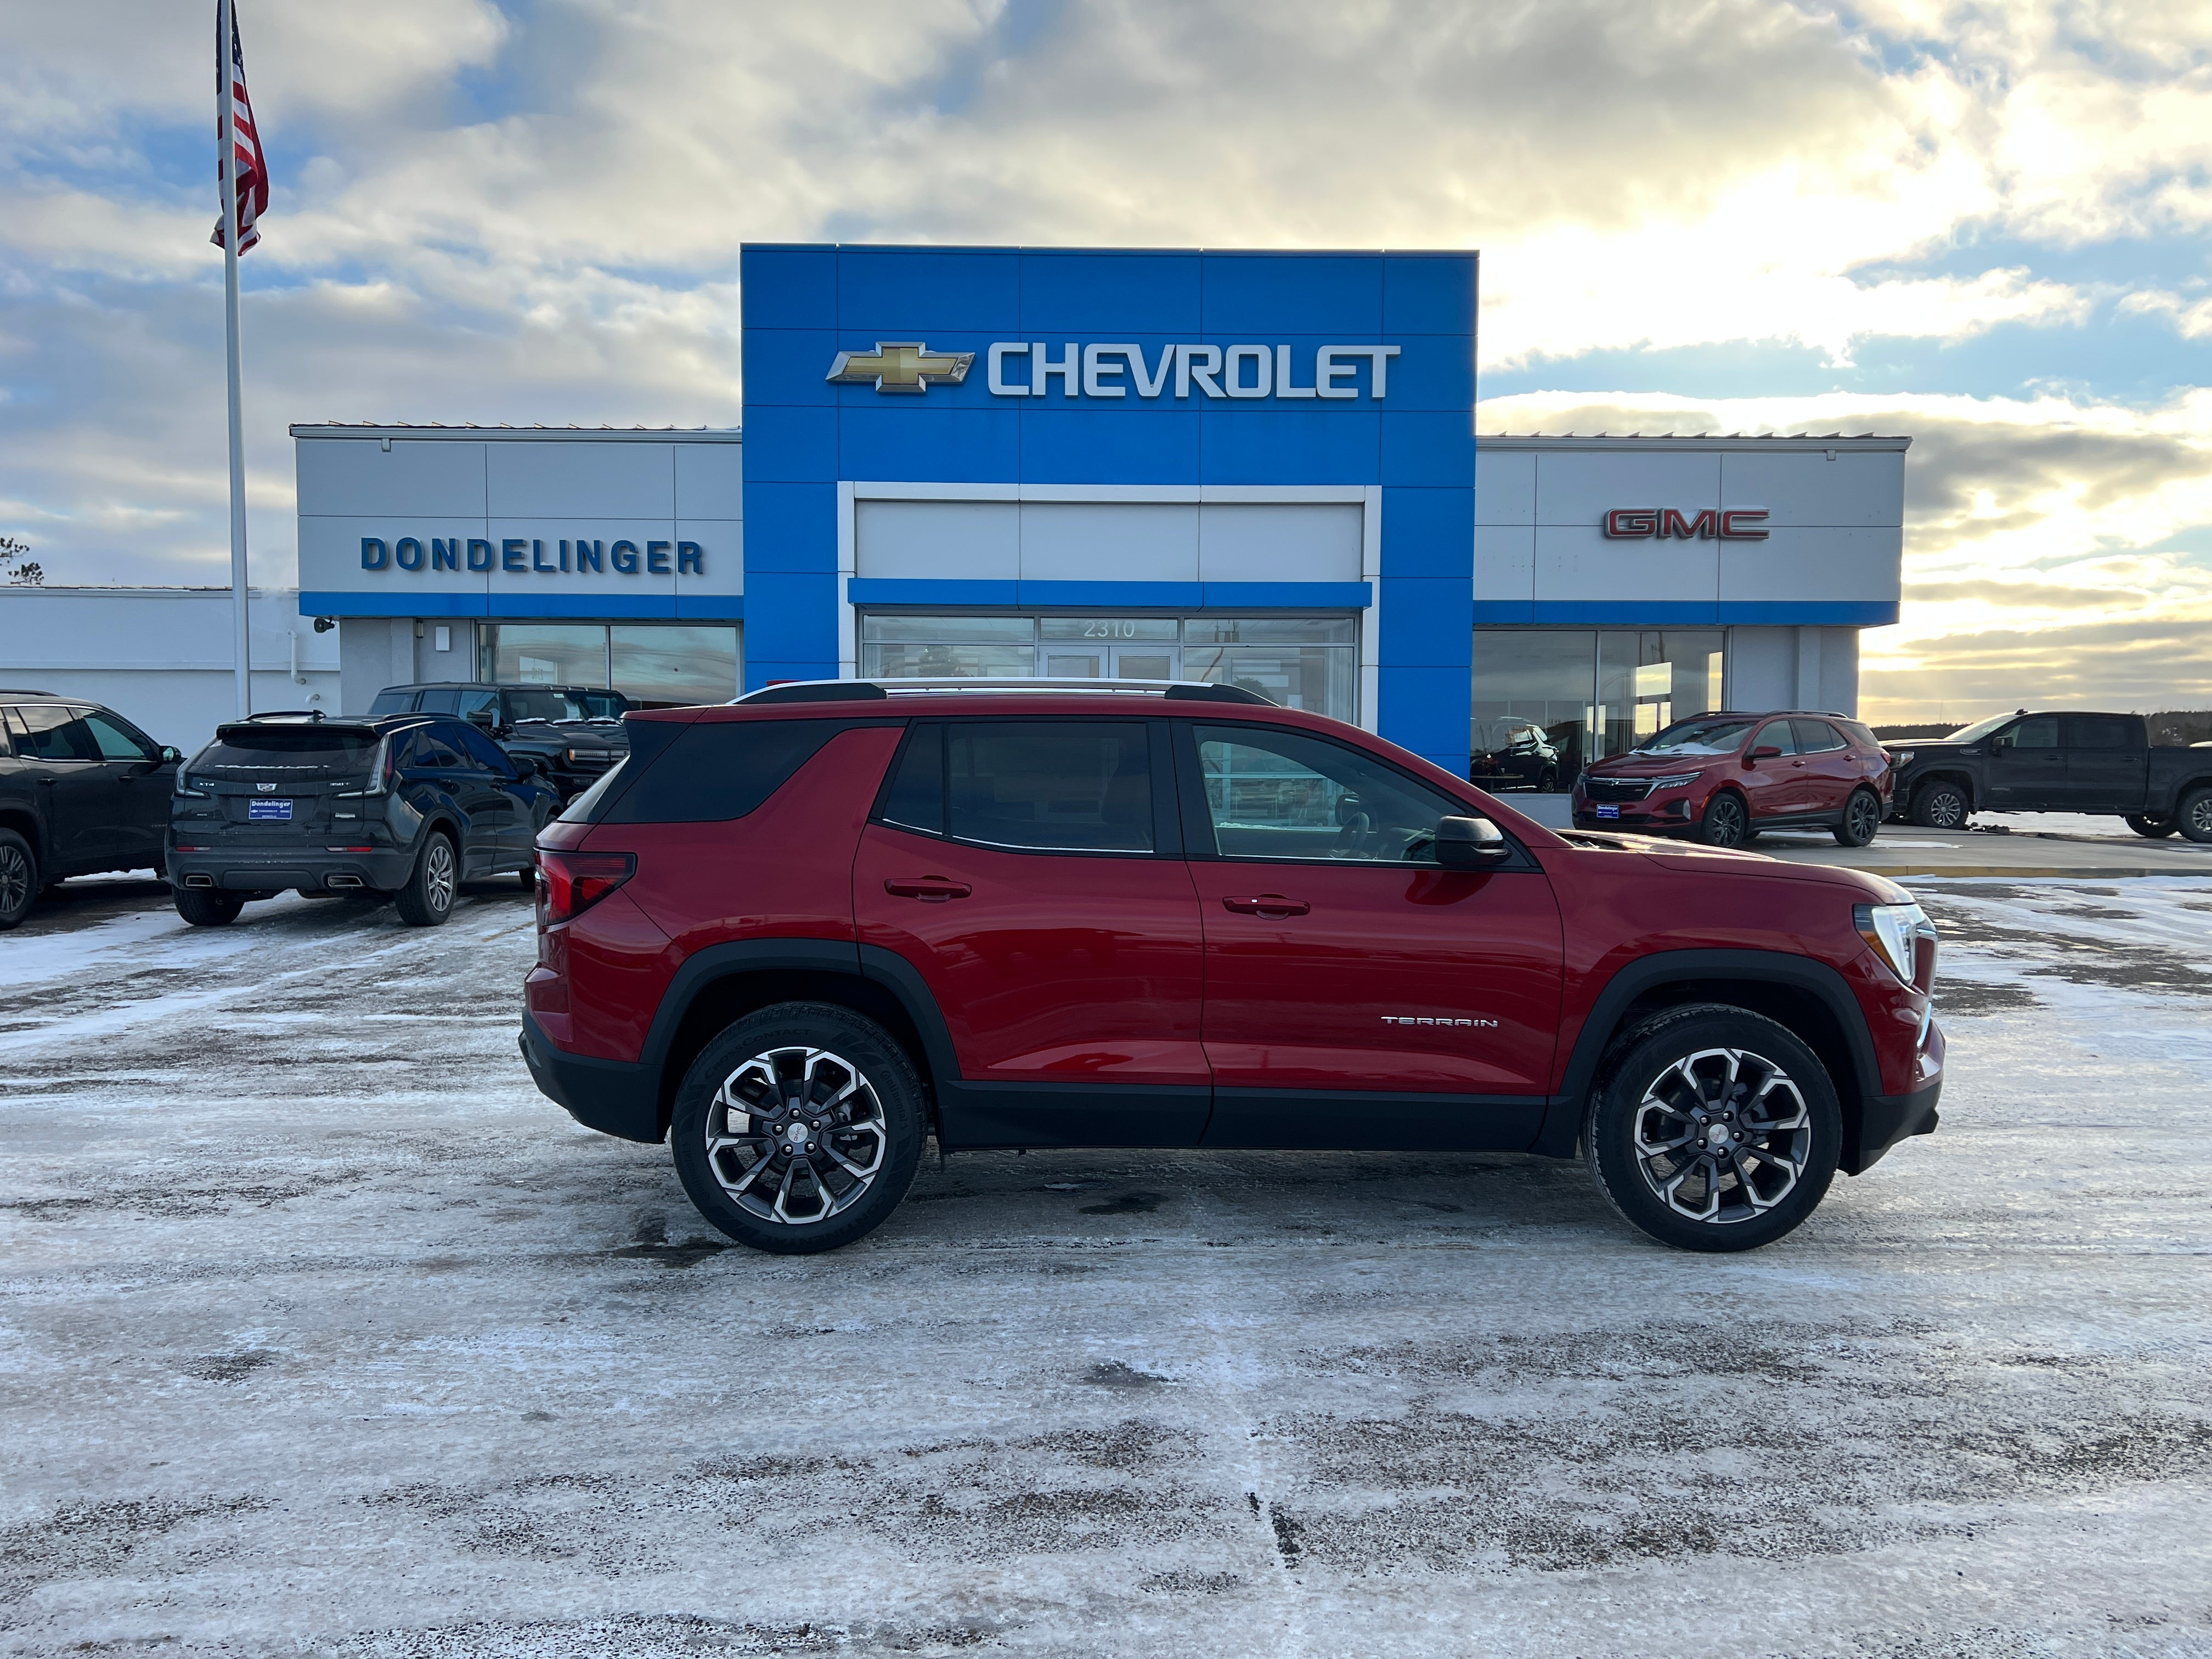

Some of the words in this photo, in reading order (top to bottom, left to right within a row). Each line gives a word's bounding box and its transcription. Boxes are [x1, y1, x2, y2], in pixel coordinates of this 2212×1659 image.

[988, 342, 1401, 398] CHEVROLET
[1604, 508, 1770, 539] GMC
[361, 537, 703, 574] DONDELINGER
[1084, 620, 1135, 637] 2310
[1381, 1017, 1498, 1028] TERRAIN
[881, 1070, 907, 1124] Continental
